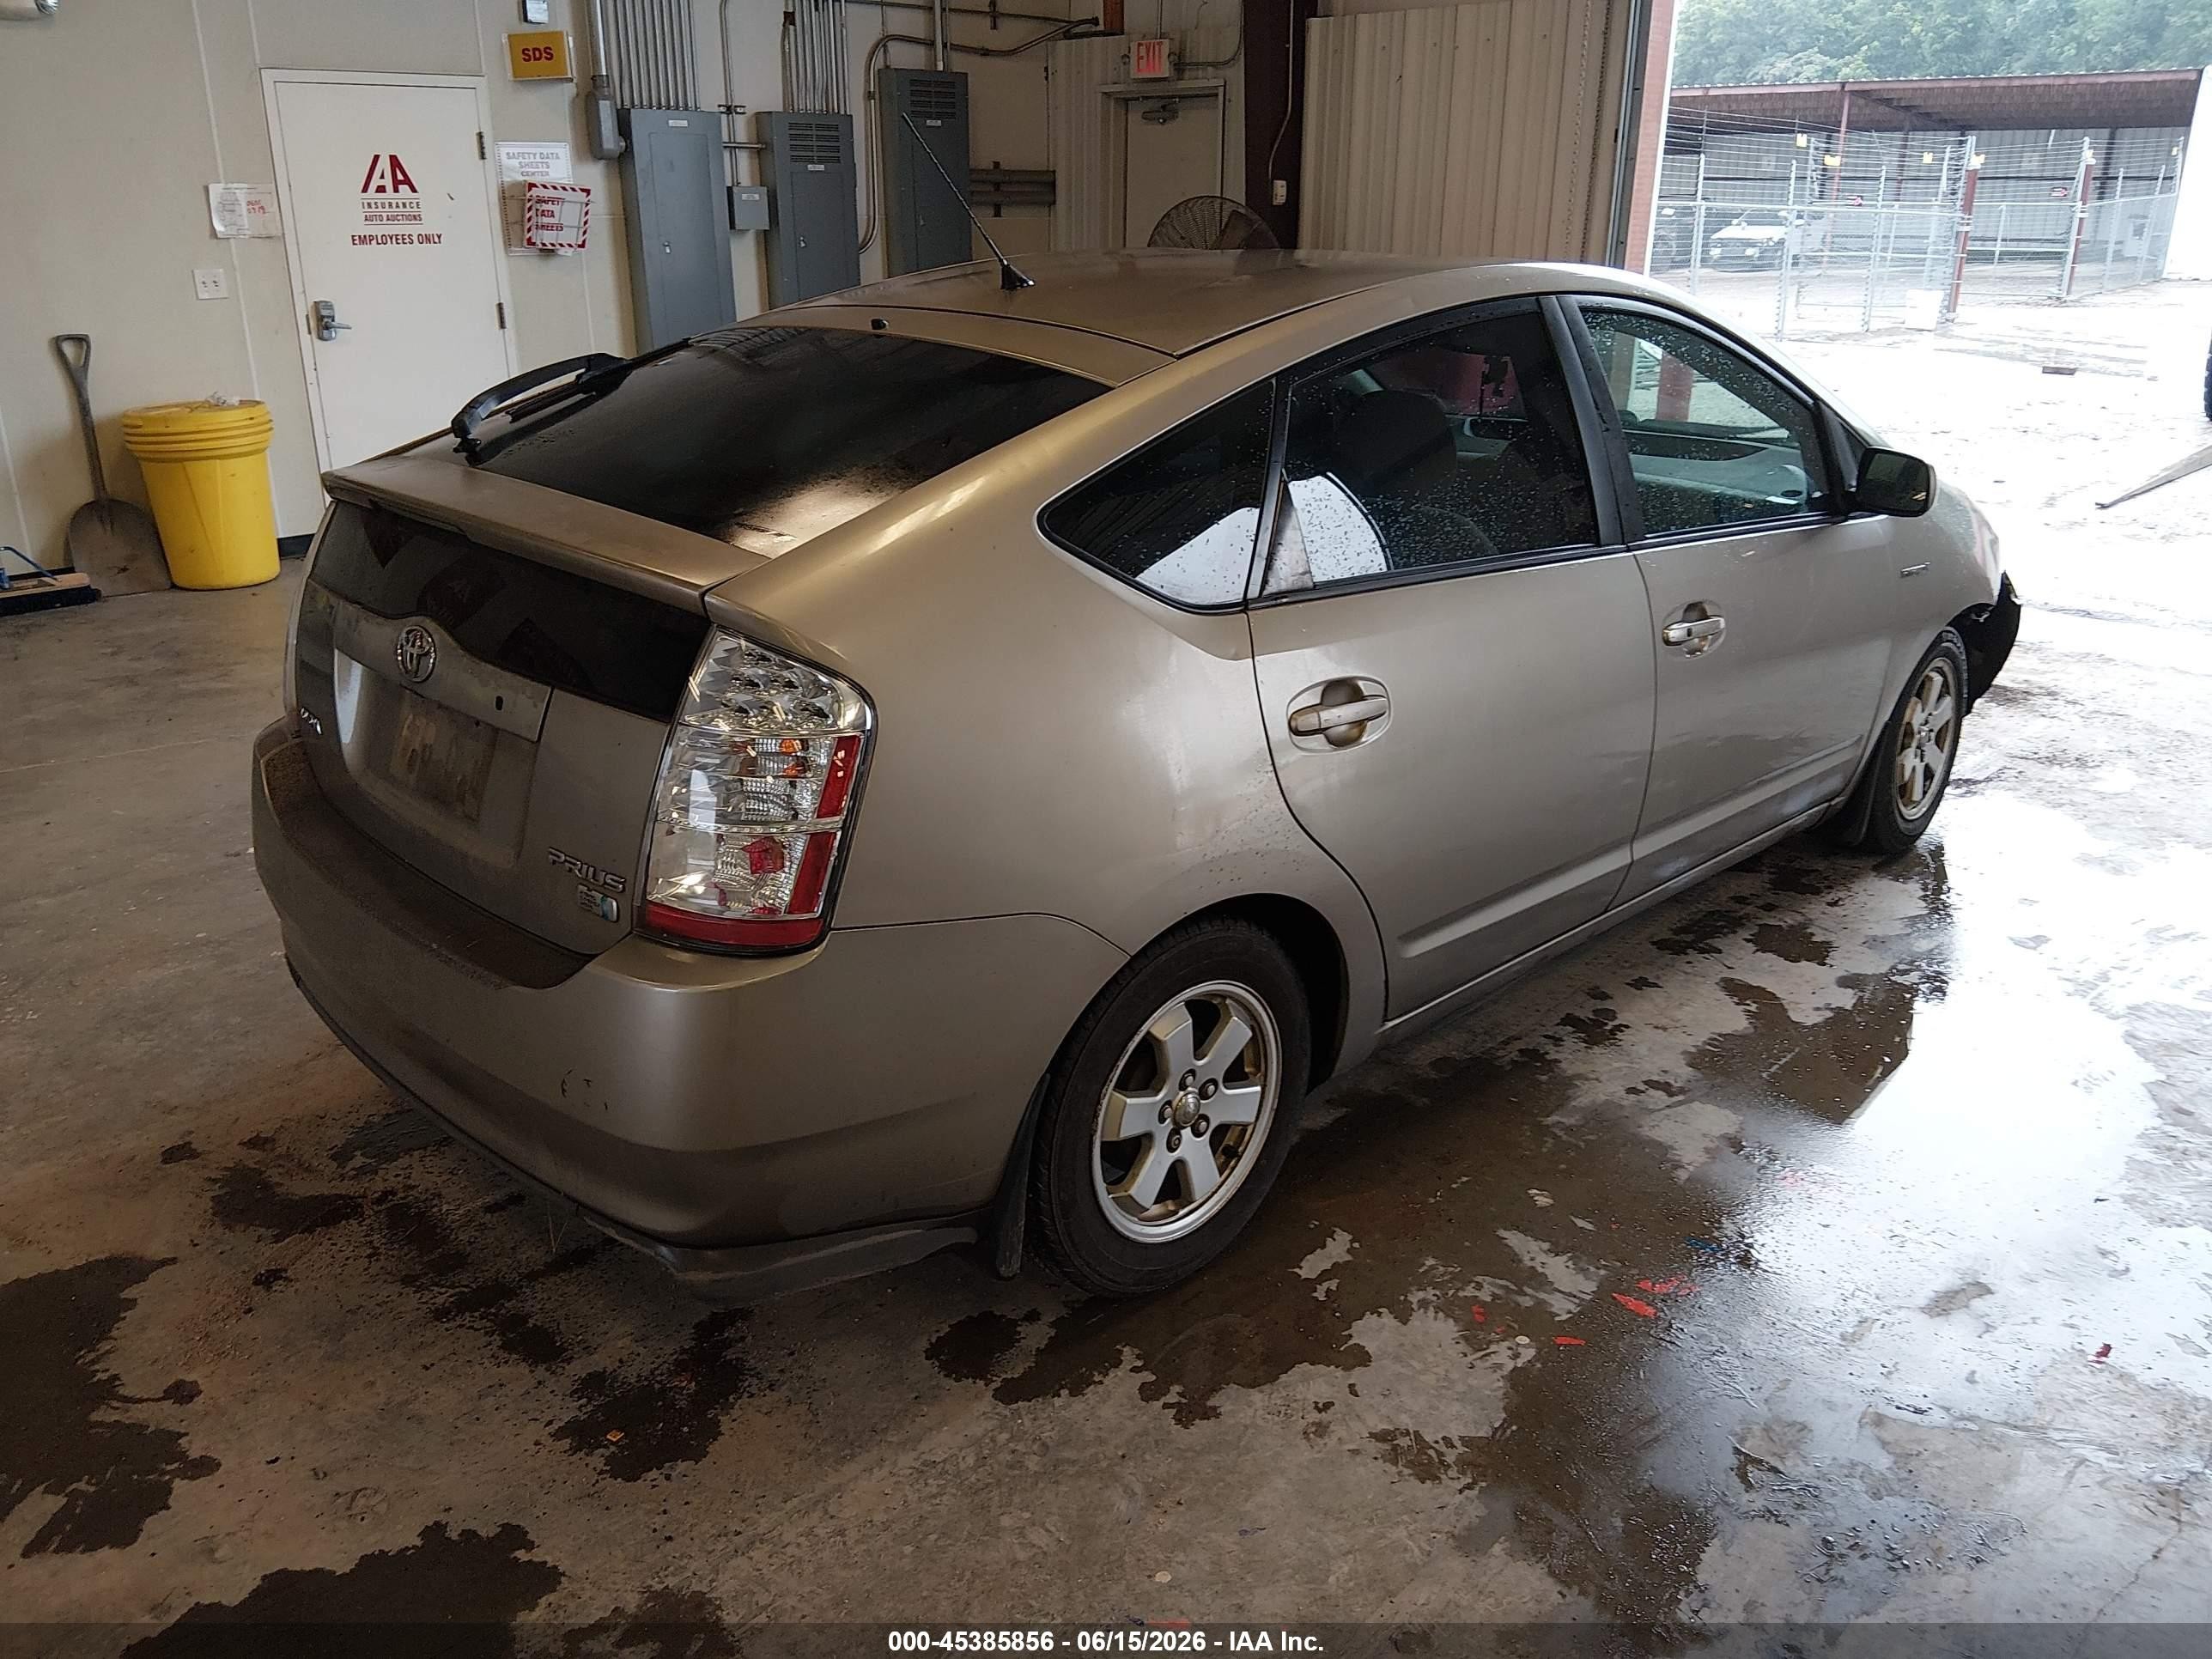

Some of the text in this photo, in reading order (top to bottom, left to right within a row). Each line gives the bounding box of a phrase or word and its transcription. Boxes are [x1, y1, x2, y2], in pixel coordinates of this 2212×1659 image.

[521, 46, 554, 63] SDS
[1137, 40, 1163, 74] EXIT
[505, 151, 561, 161] SAFETY DATA
[518, 161, 550, 170] SHEETS
[361, 201, 422, 210] INSURANCE
[363, 213, 422, 222] AUTO AUCTIONS
[350, 233, 443, 246] EMPLOYEES ONLY
[547, 846, 627, 894] PRIUS
